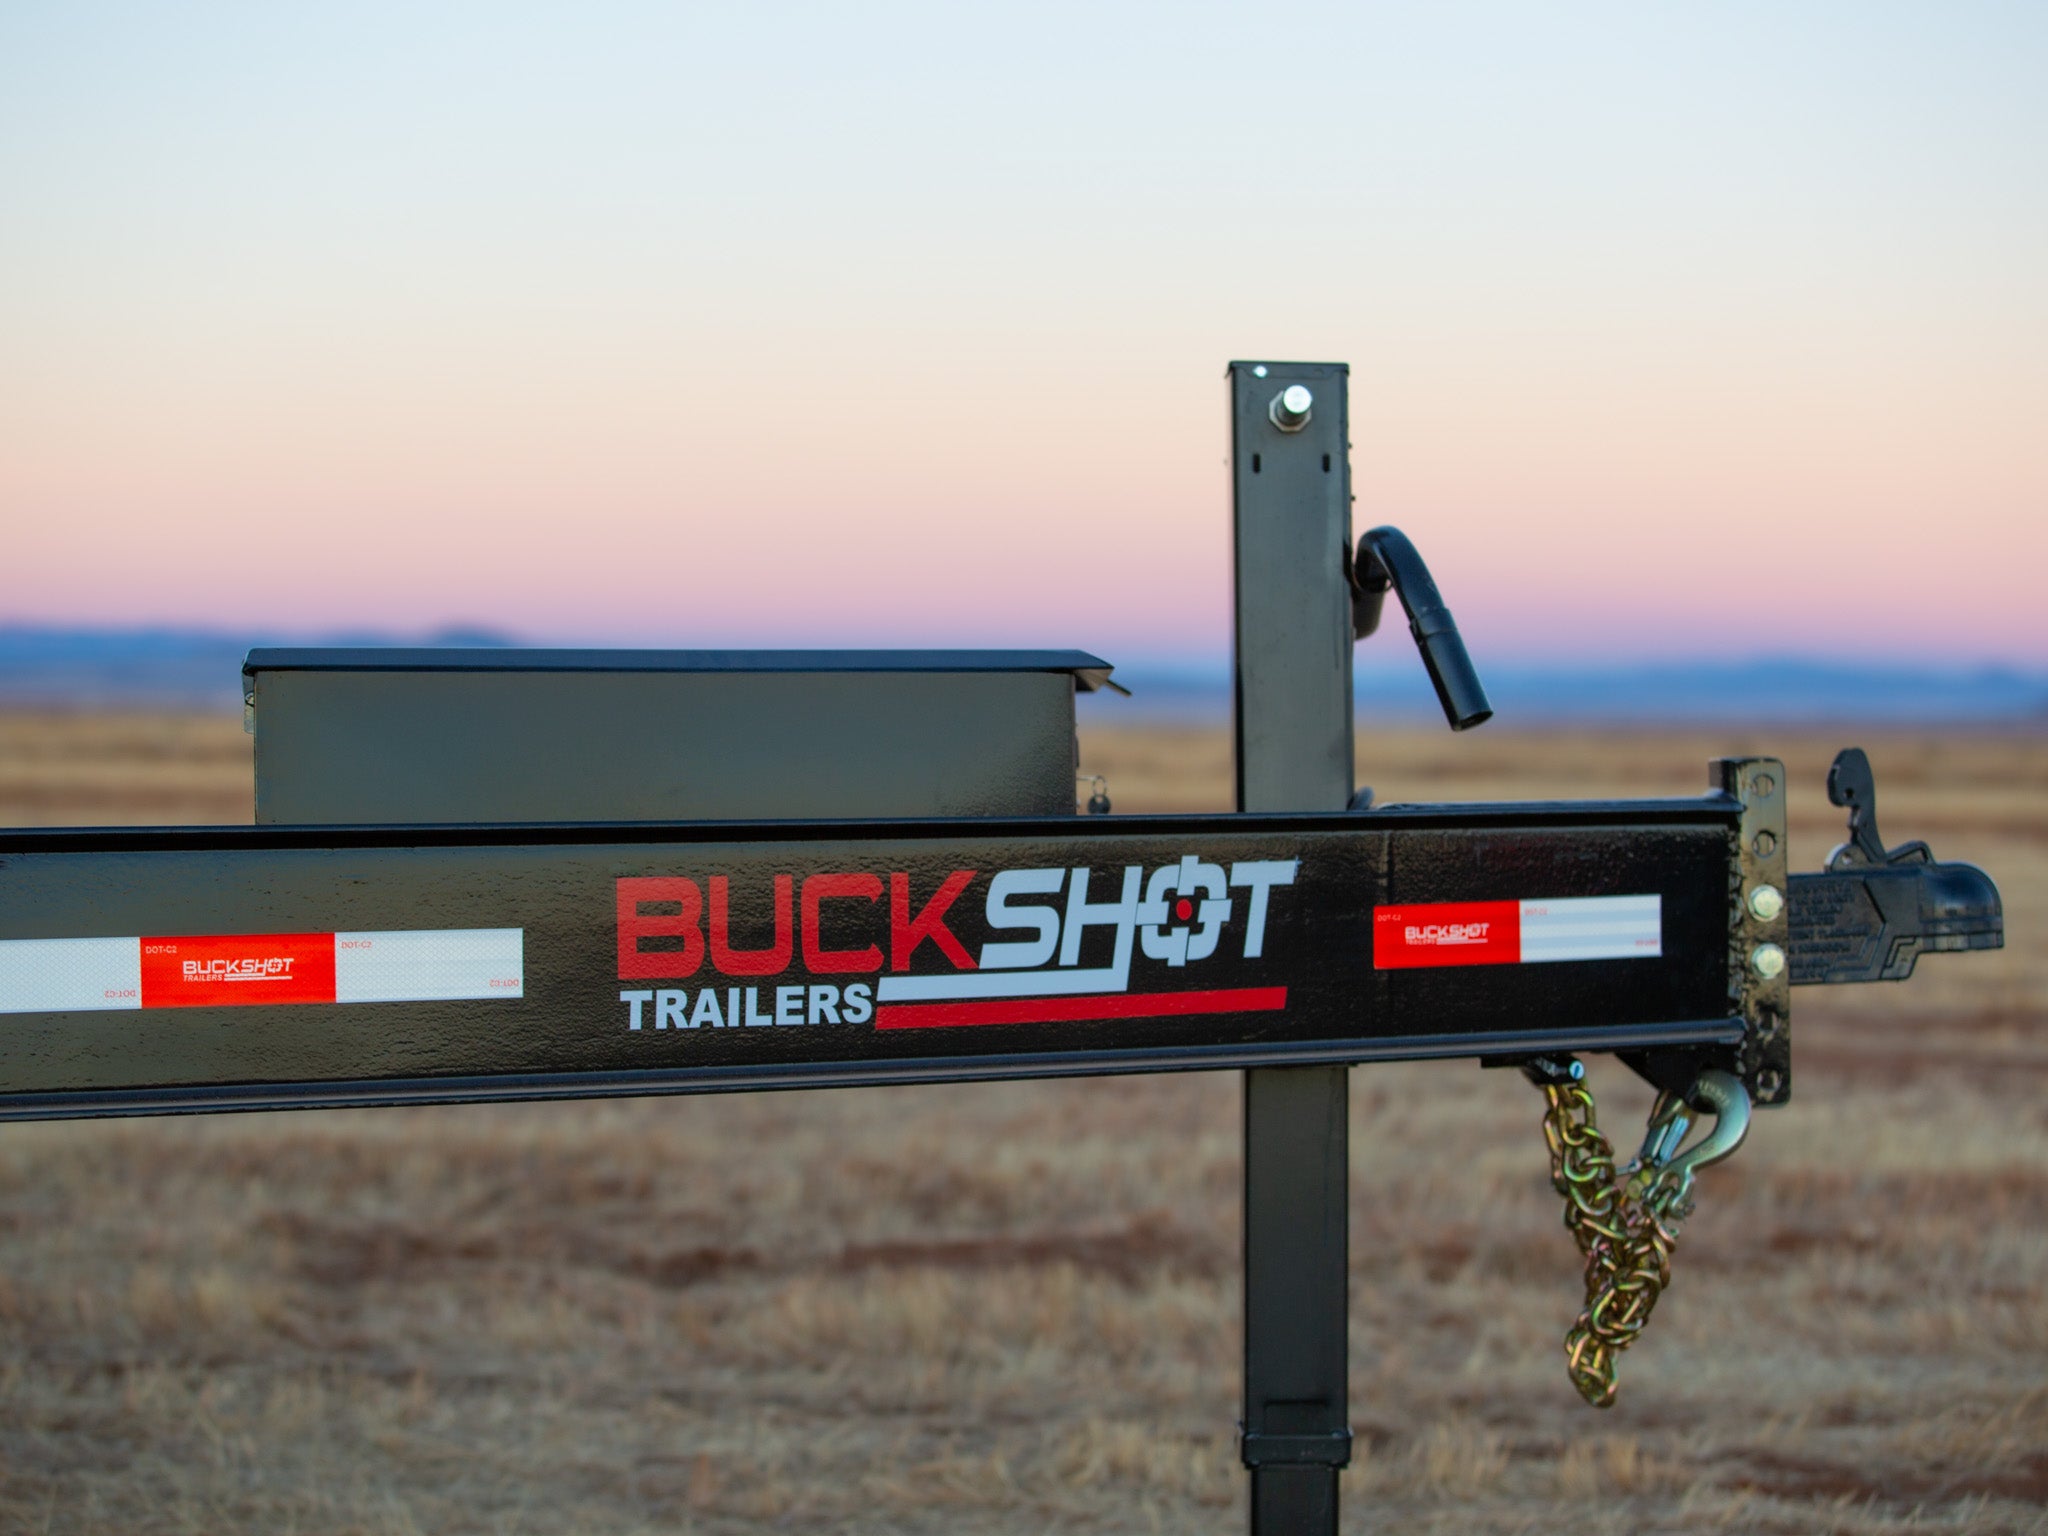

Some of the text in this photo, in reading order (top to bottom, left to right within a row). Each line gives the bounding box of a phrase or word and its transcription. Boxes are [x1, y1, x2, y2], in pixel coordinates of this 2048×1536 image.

[616, 855, 1300, 988] BUCKSHOT
[1405, 923, 1490, 940] BUCKSHOT
[145, 945, 177, 954] DOT-C2
[341, 941, 372, 949] DOT-C2
[183, 957, 294, 976] BUCKSHOT
[183, 974, 223, 982] TRAILERS
[489, 979, 519, 987] DOT-C2
[104, 990, 136, 998] DOT-C2
[620, 984, 873, 1031] TRAILERS
